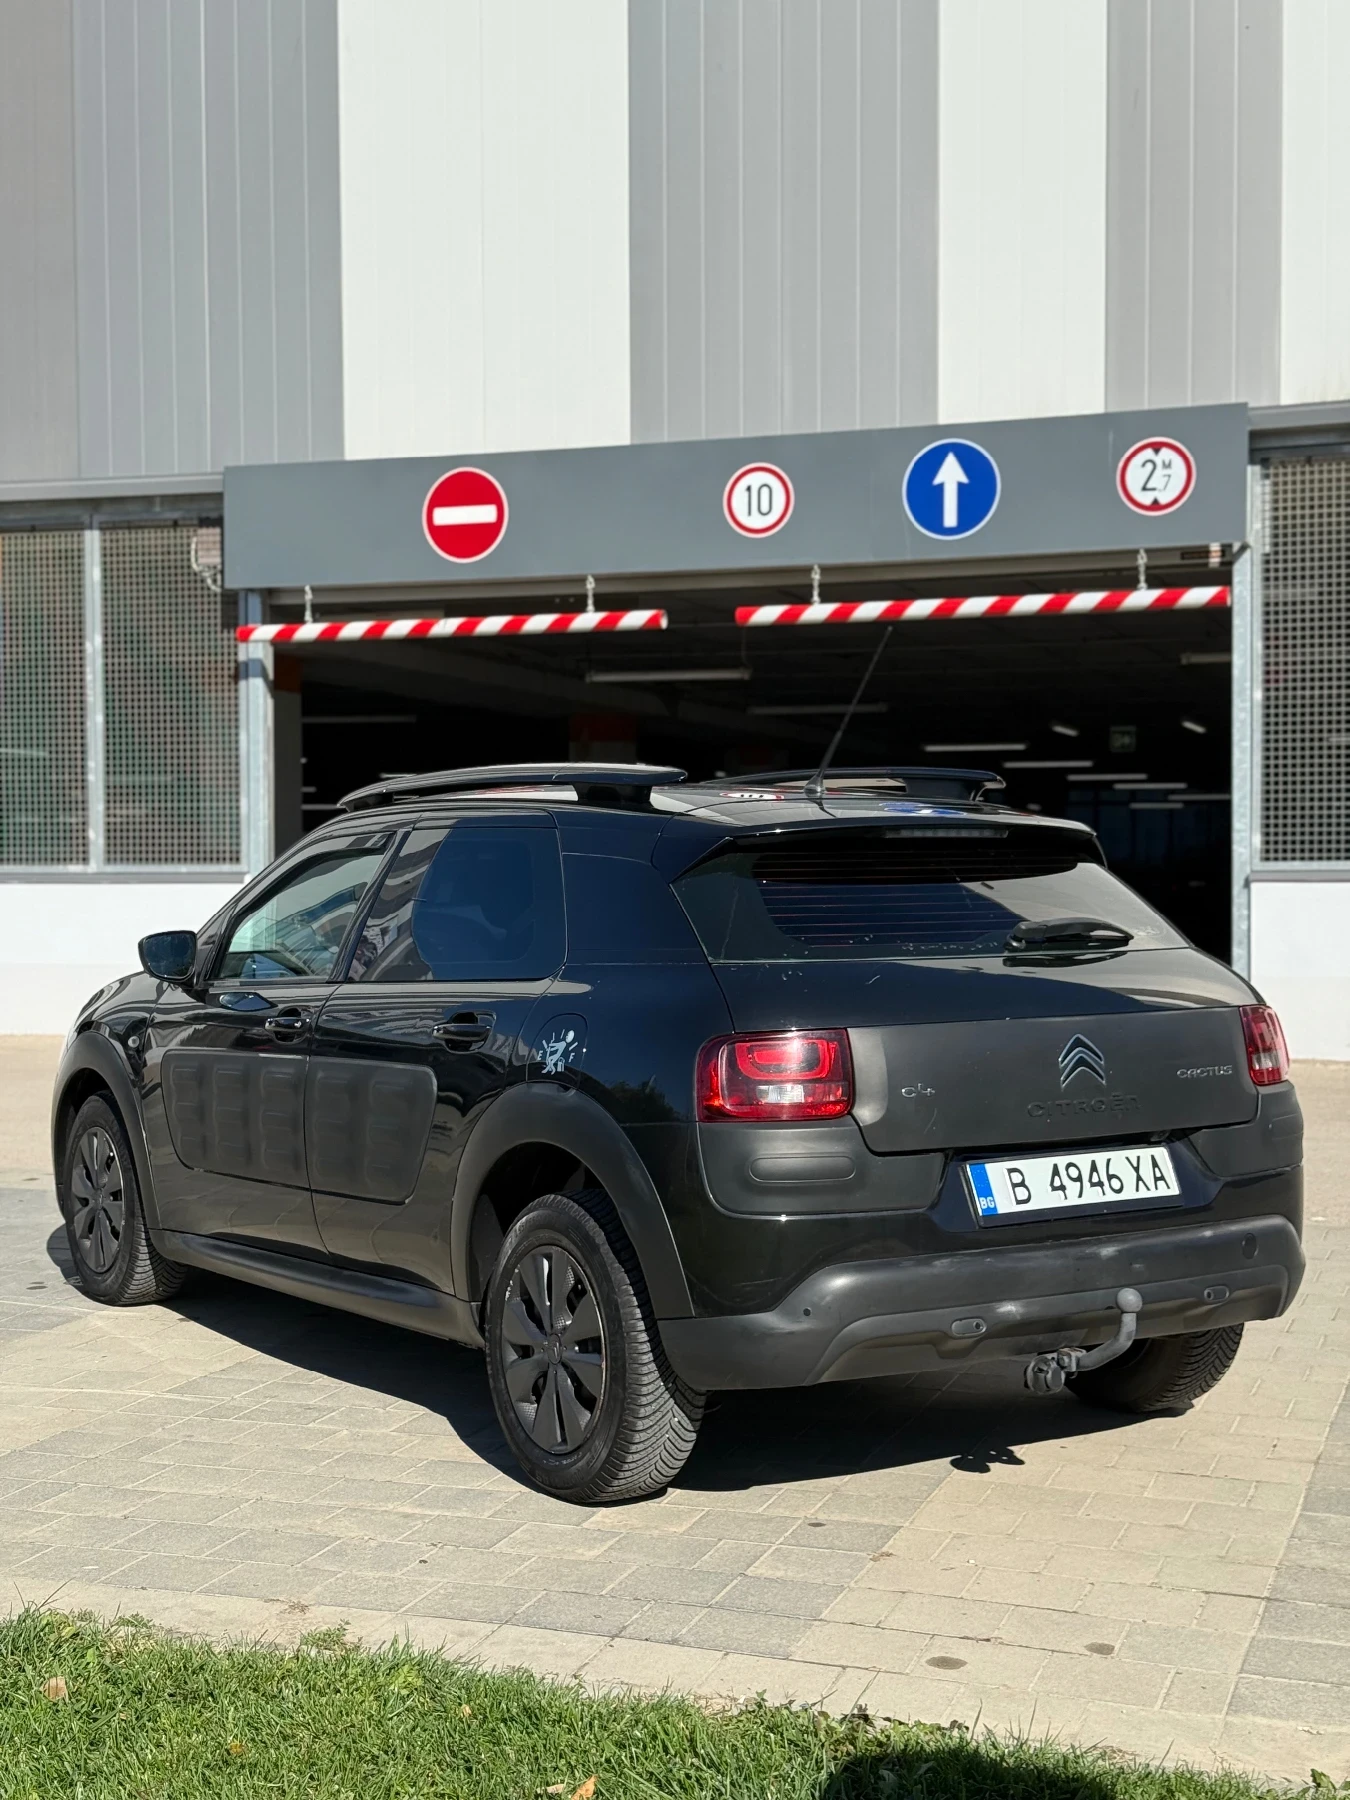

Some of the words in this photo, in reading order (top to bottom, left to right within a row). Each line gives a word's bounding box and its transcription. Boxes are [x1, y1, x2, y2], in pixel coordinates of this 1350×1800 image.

[745, 483, 773, 516] 10
[1176, 1064, 1233, 1079] CACTUS
[901, 1082, 936, 1098] C4
[1006, 1167, 1032, 1206] B
[1049, 1157, 1124, 1200] 4946
[1125, 1154, 1171, 1193] XA
[979, 1196, 996, 1209] BG
